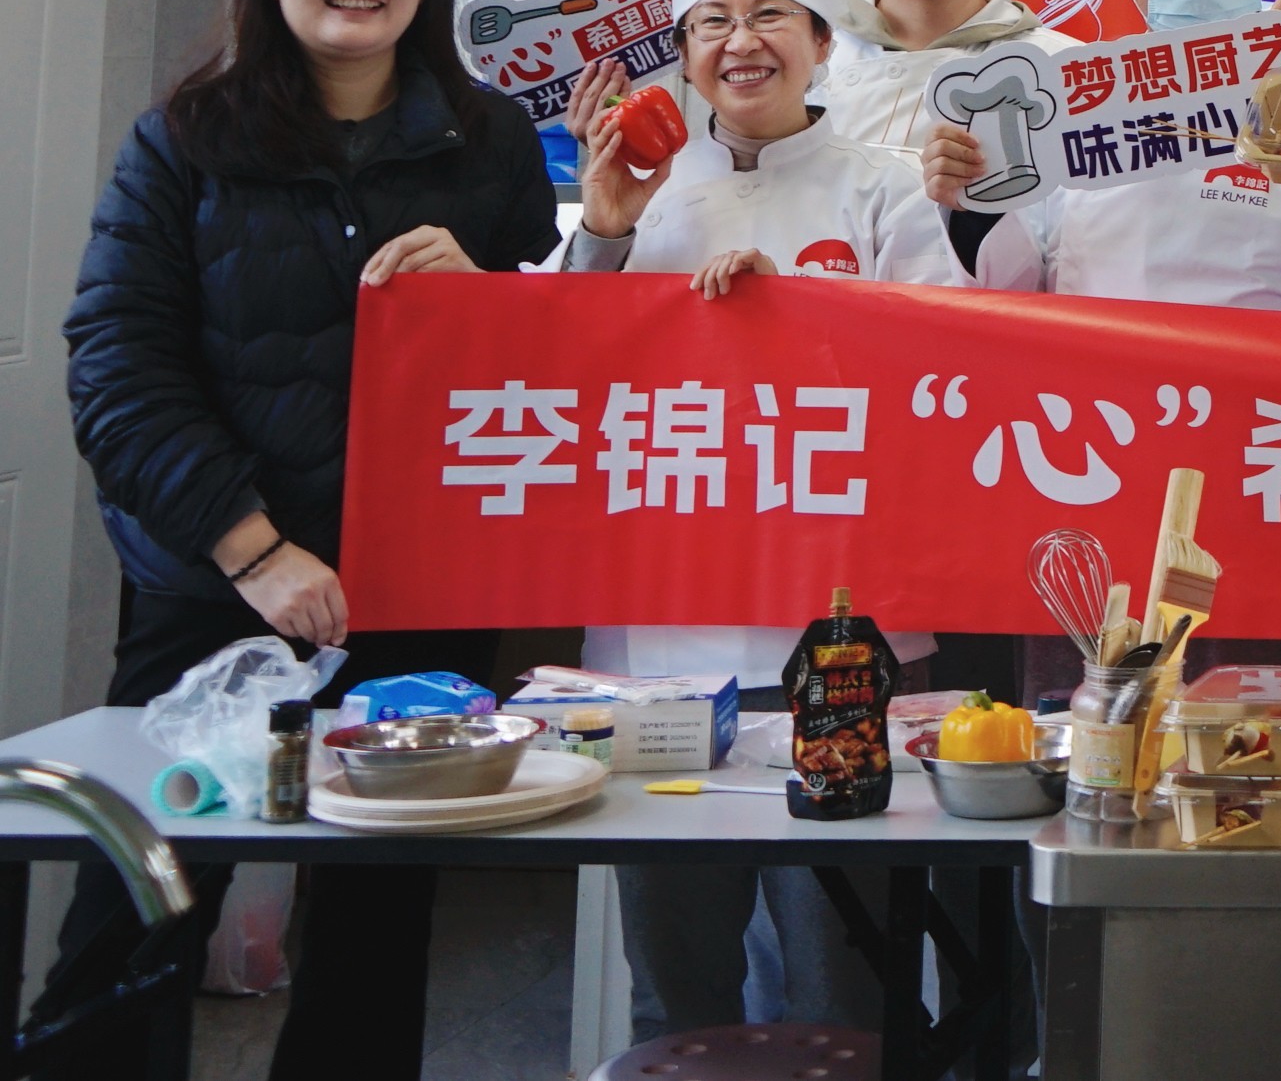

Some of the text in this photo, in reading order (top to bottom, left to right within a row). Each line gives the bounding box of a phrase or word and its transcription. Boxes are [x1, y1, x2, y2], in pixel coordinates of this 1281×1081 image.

[480, 27, 562, 88] “心”
[1234, 175, 1268, 191] 李錦記
[1200, 188, 1269, 208] LEE KUM KEE
